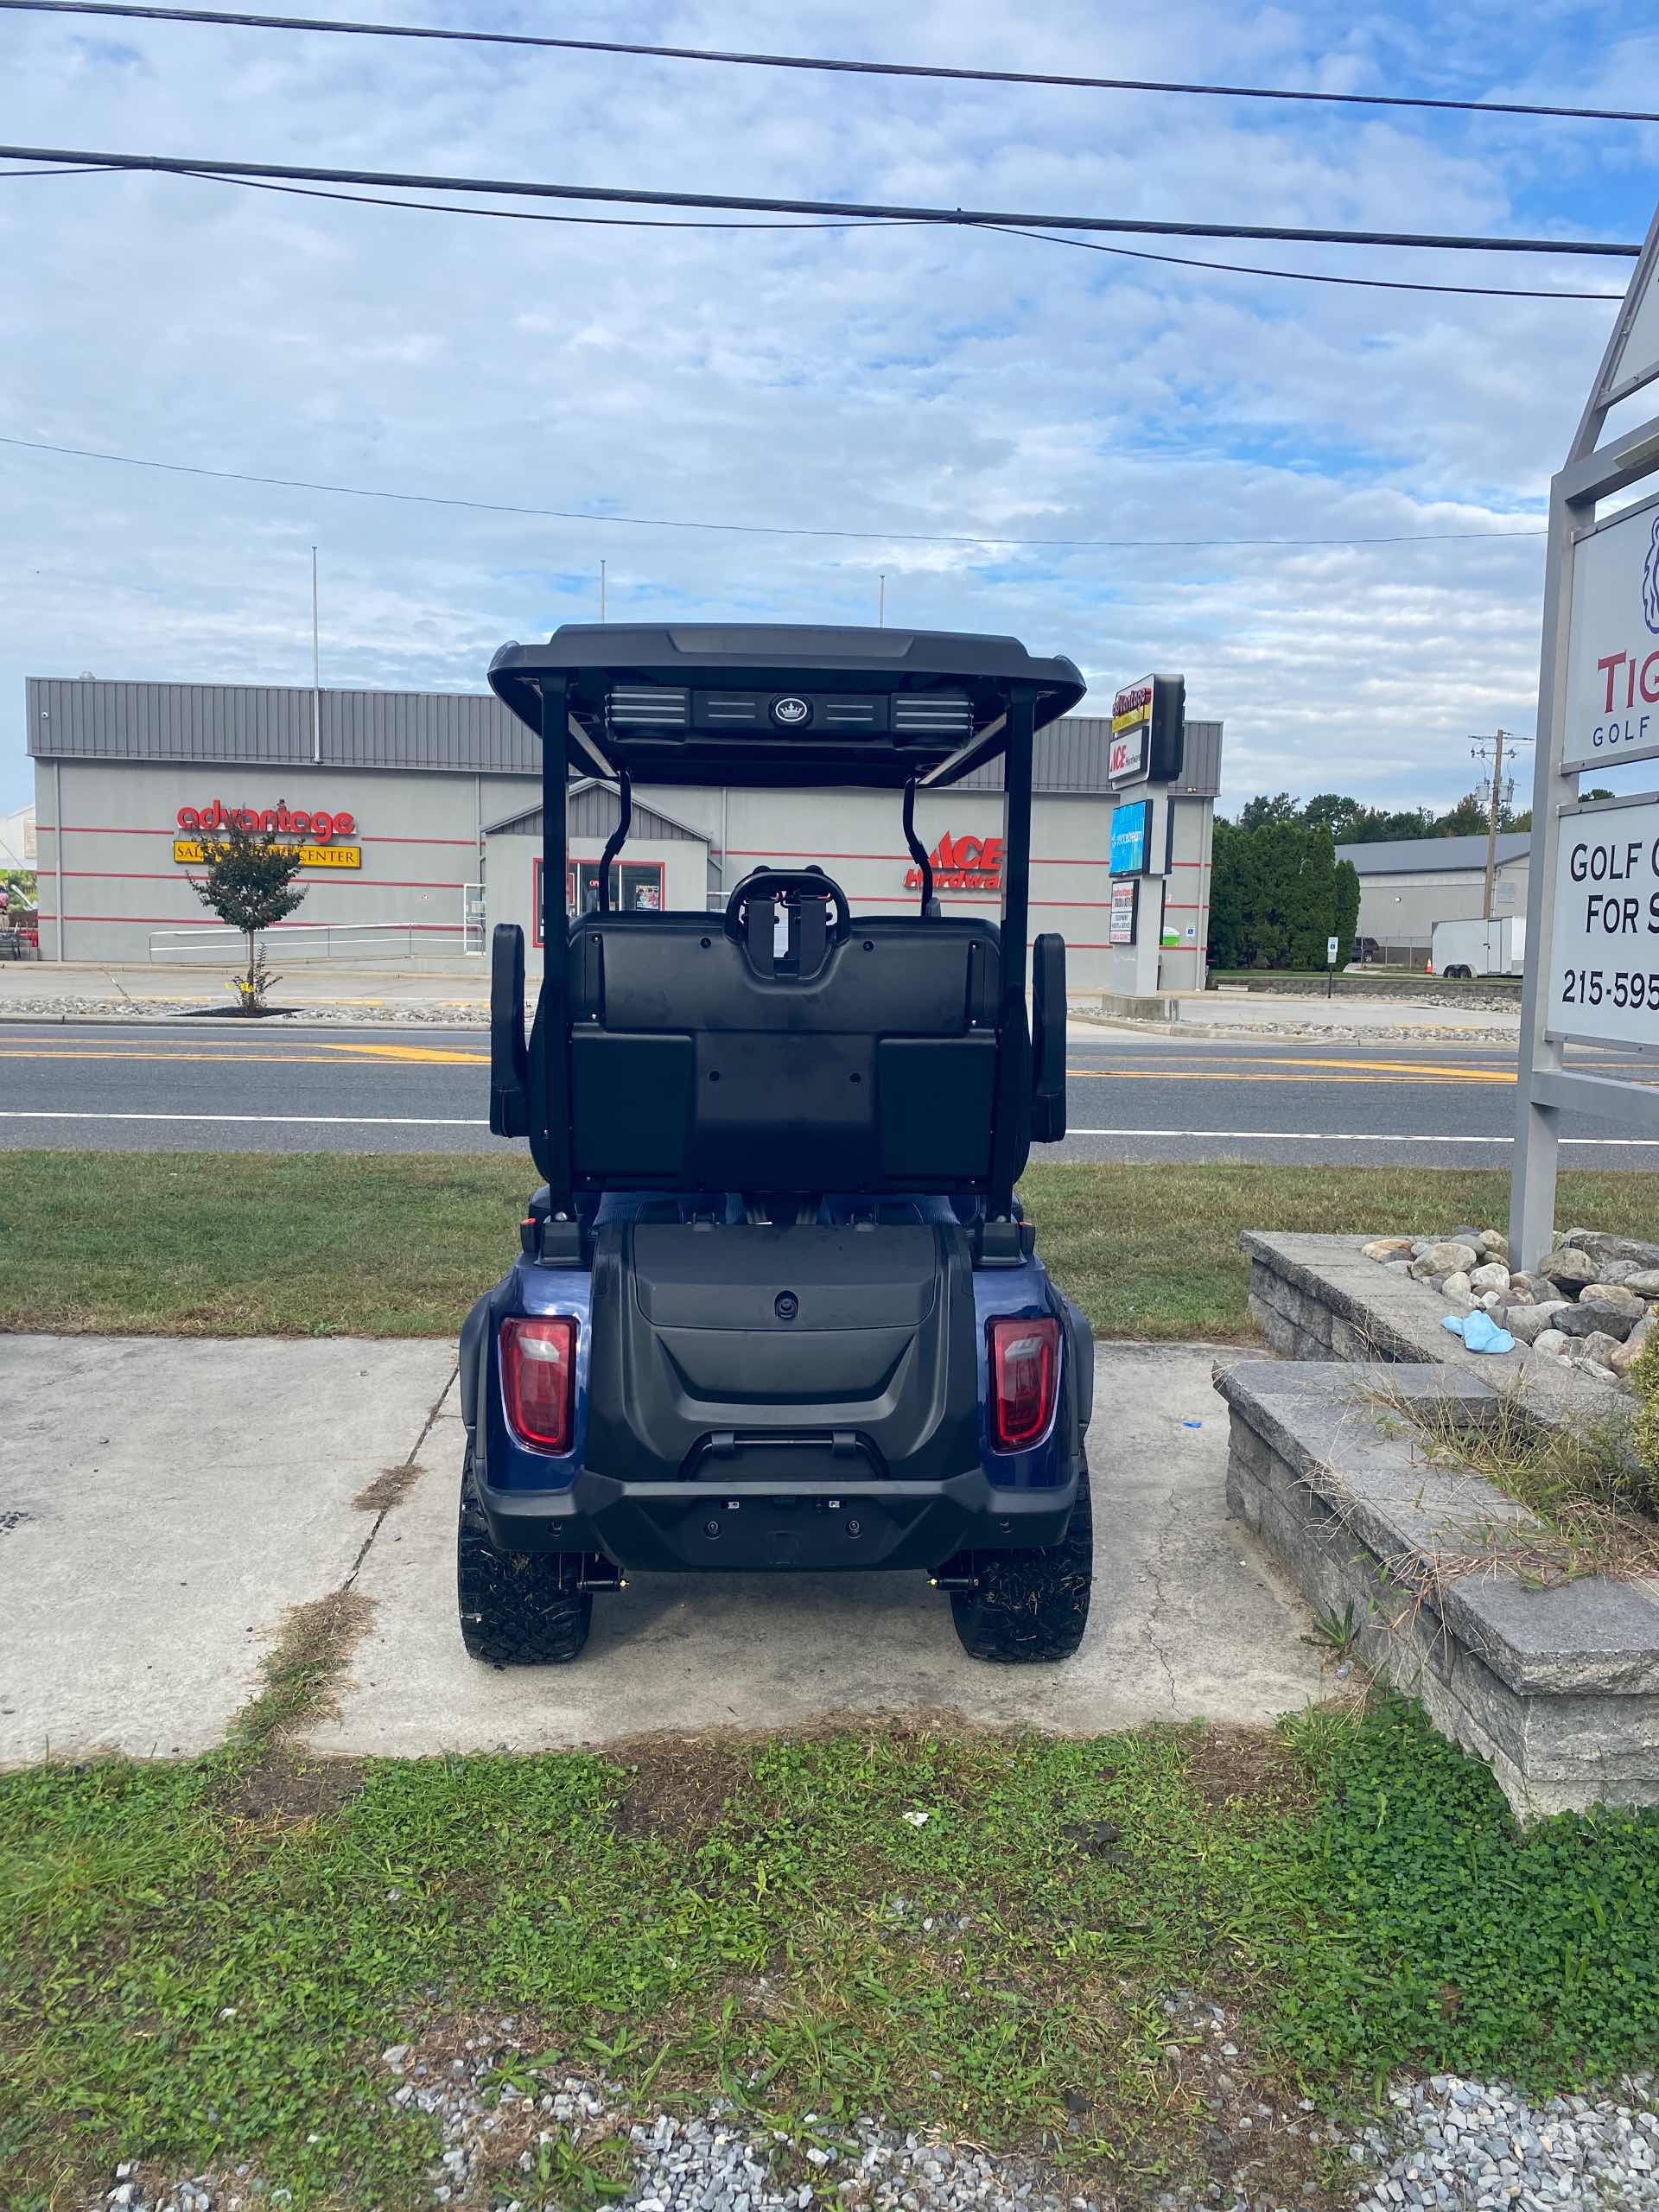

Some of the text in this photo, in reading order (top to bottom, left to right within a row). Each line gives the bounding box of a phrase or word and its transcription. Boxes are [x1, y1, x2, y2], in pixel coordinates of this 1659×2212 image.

[1597, 649, 1659, 714] TIG
[1592, 715, 1650, 747] GOLF
[927, 830, 1004, 871] ACE
[1570, 842, 1643, 882] GOLF
[1586, 893, 1640, 934] FOR
